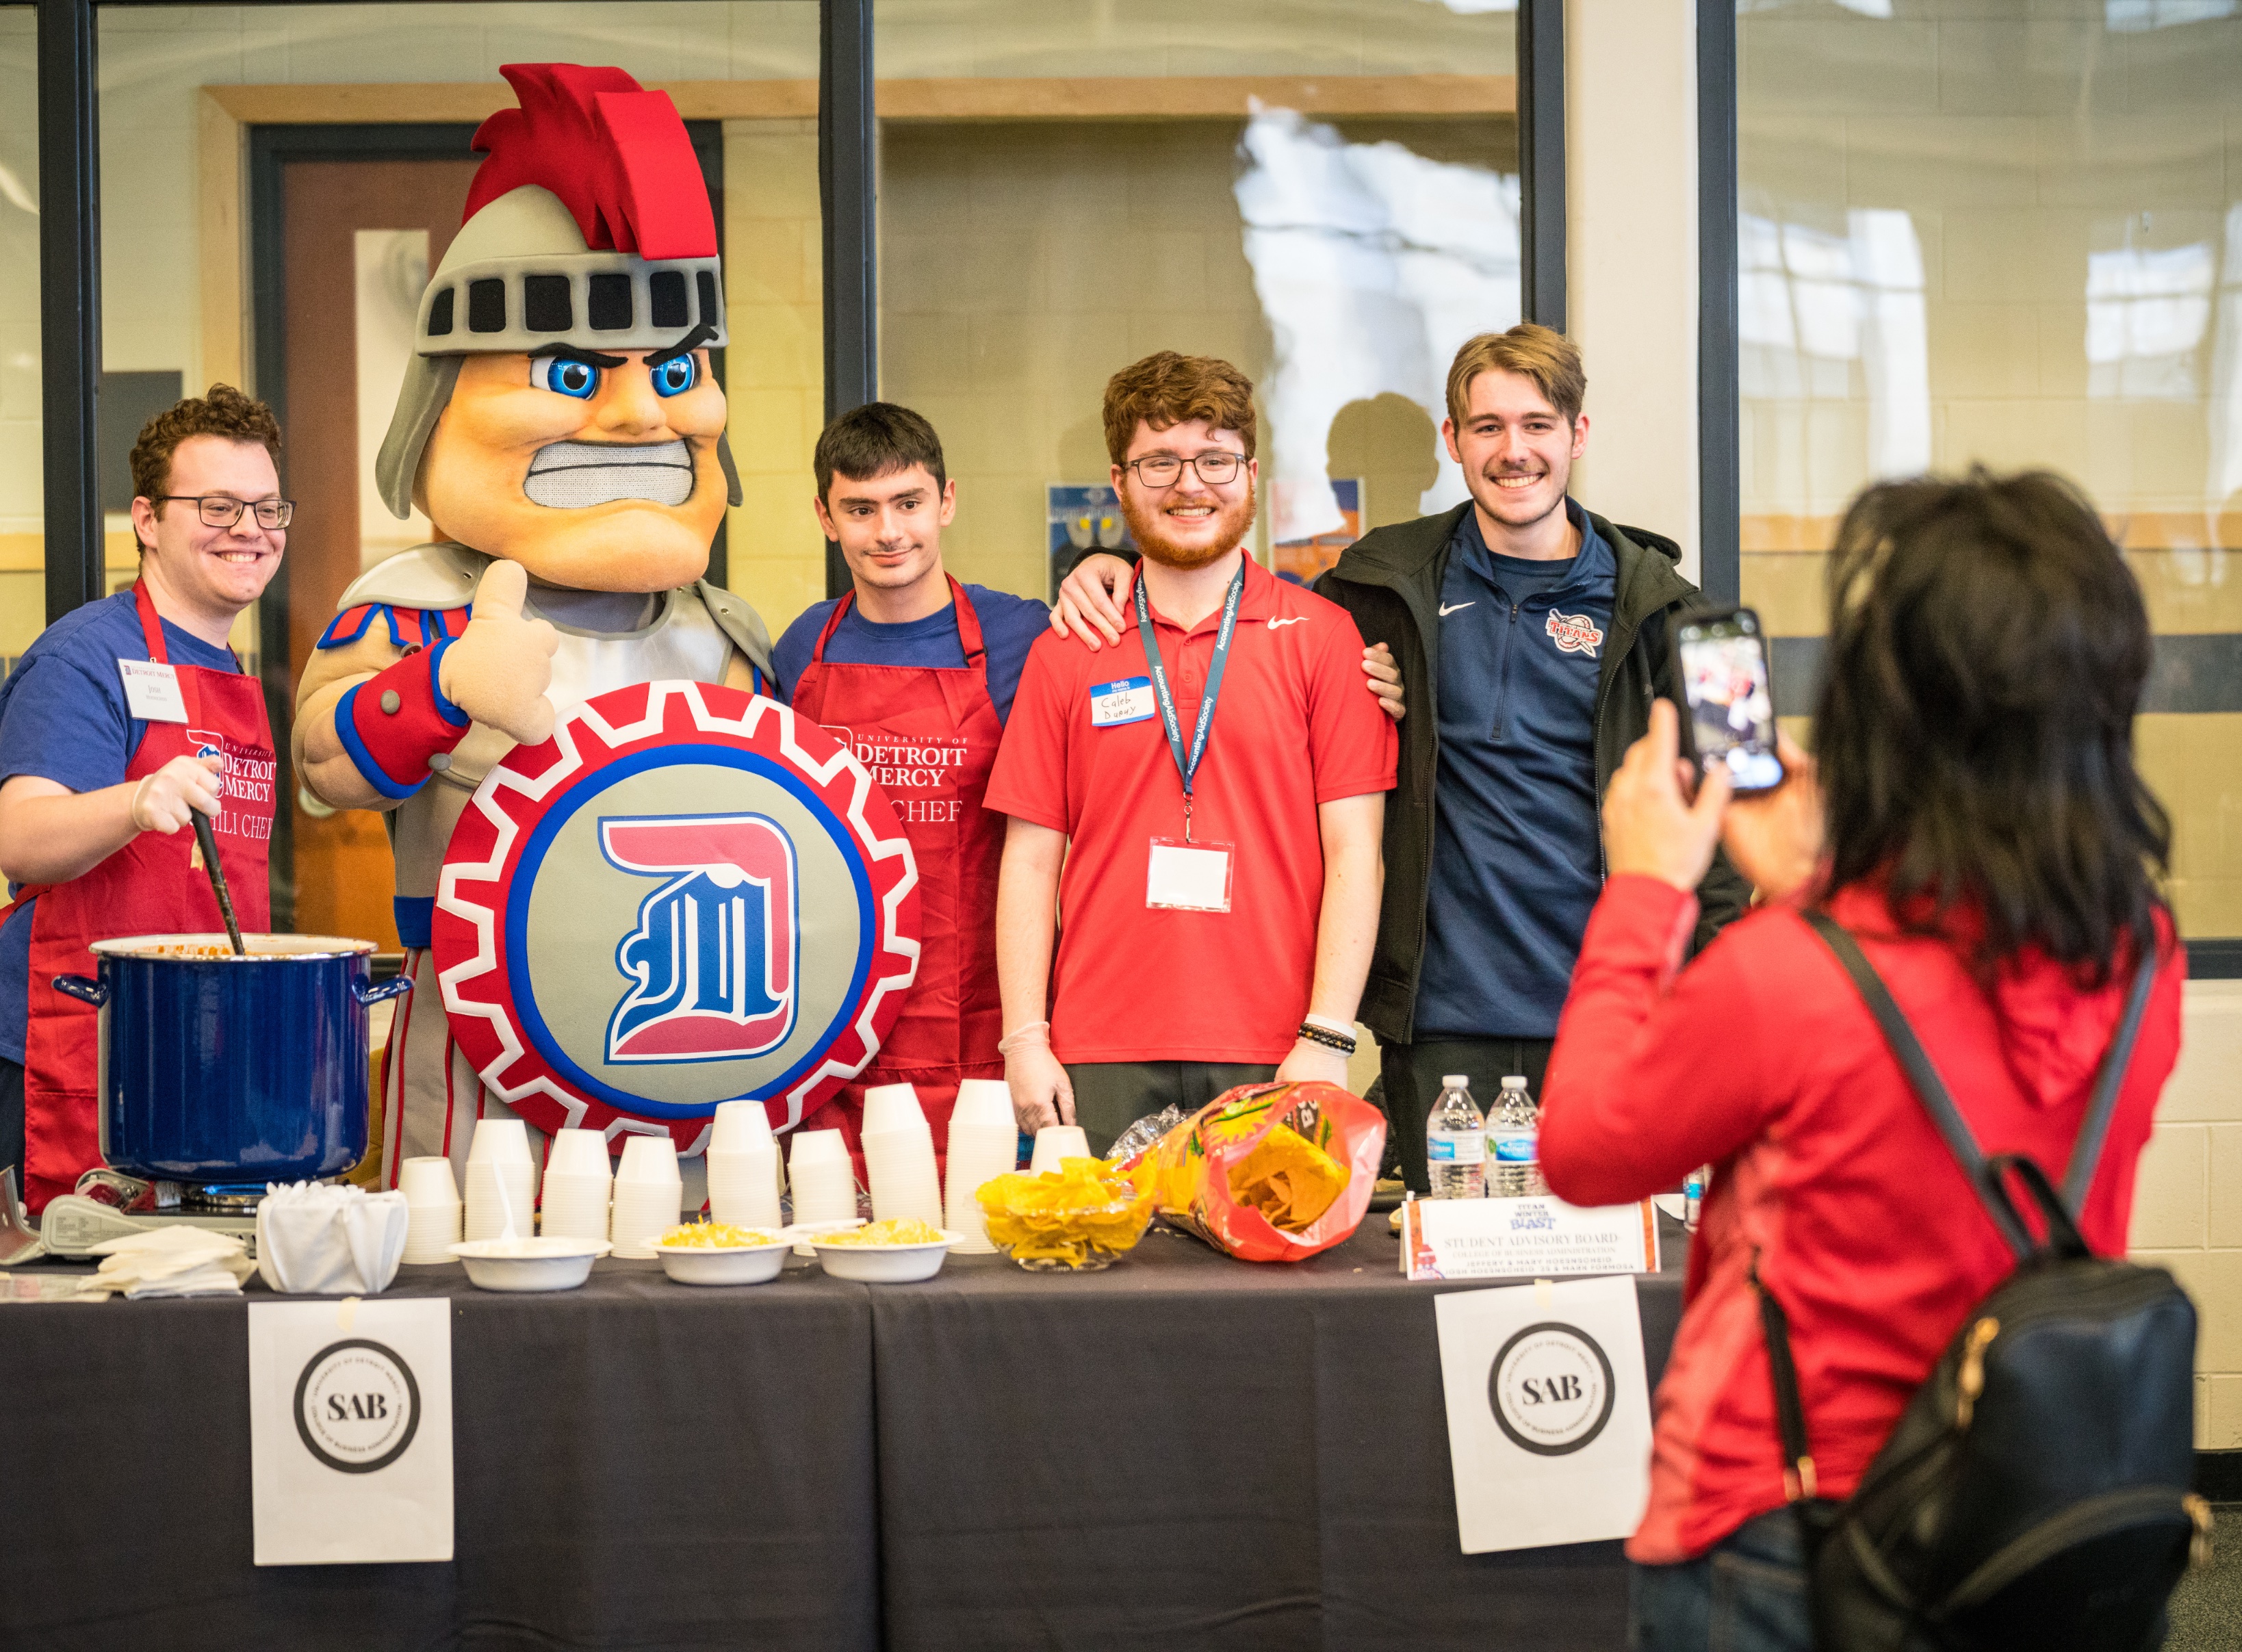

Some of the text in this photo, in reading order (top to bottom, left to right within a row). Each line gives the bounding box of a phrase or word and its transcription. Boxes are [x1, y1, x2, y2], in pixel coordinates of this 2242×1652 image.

[1216, 580, 1242, 650] AccountingAidSociety
[1549, 621, 1599, 643] TITANS
[1111, 680, 1129, 690] Hello
[1101, 692, 1131, 708] Caleb
[1154, 665, 1180, 742] AccountingAidSociety
[858, 734, 942, 744] UNIVERSITY
[1187, 696, 1213, 775] AccountingAidSociety
[225, 743, 272, 758] UNIVERSITY
[855, 743, 967, 766] DETROIT
[224, 775, 270, 802] MERCY
[1510, 1217, 1556, 1230] BLAST
[1444, 1232, 1619, 1248] STUDENT ADVISORY BOARD
[1521, 1374, 1582, 1406] SAB
[327, 1393, 387, 1422] SAB
